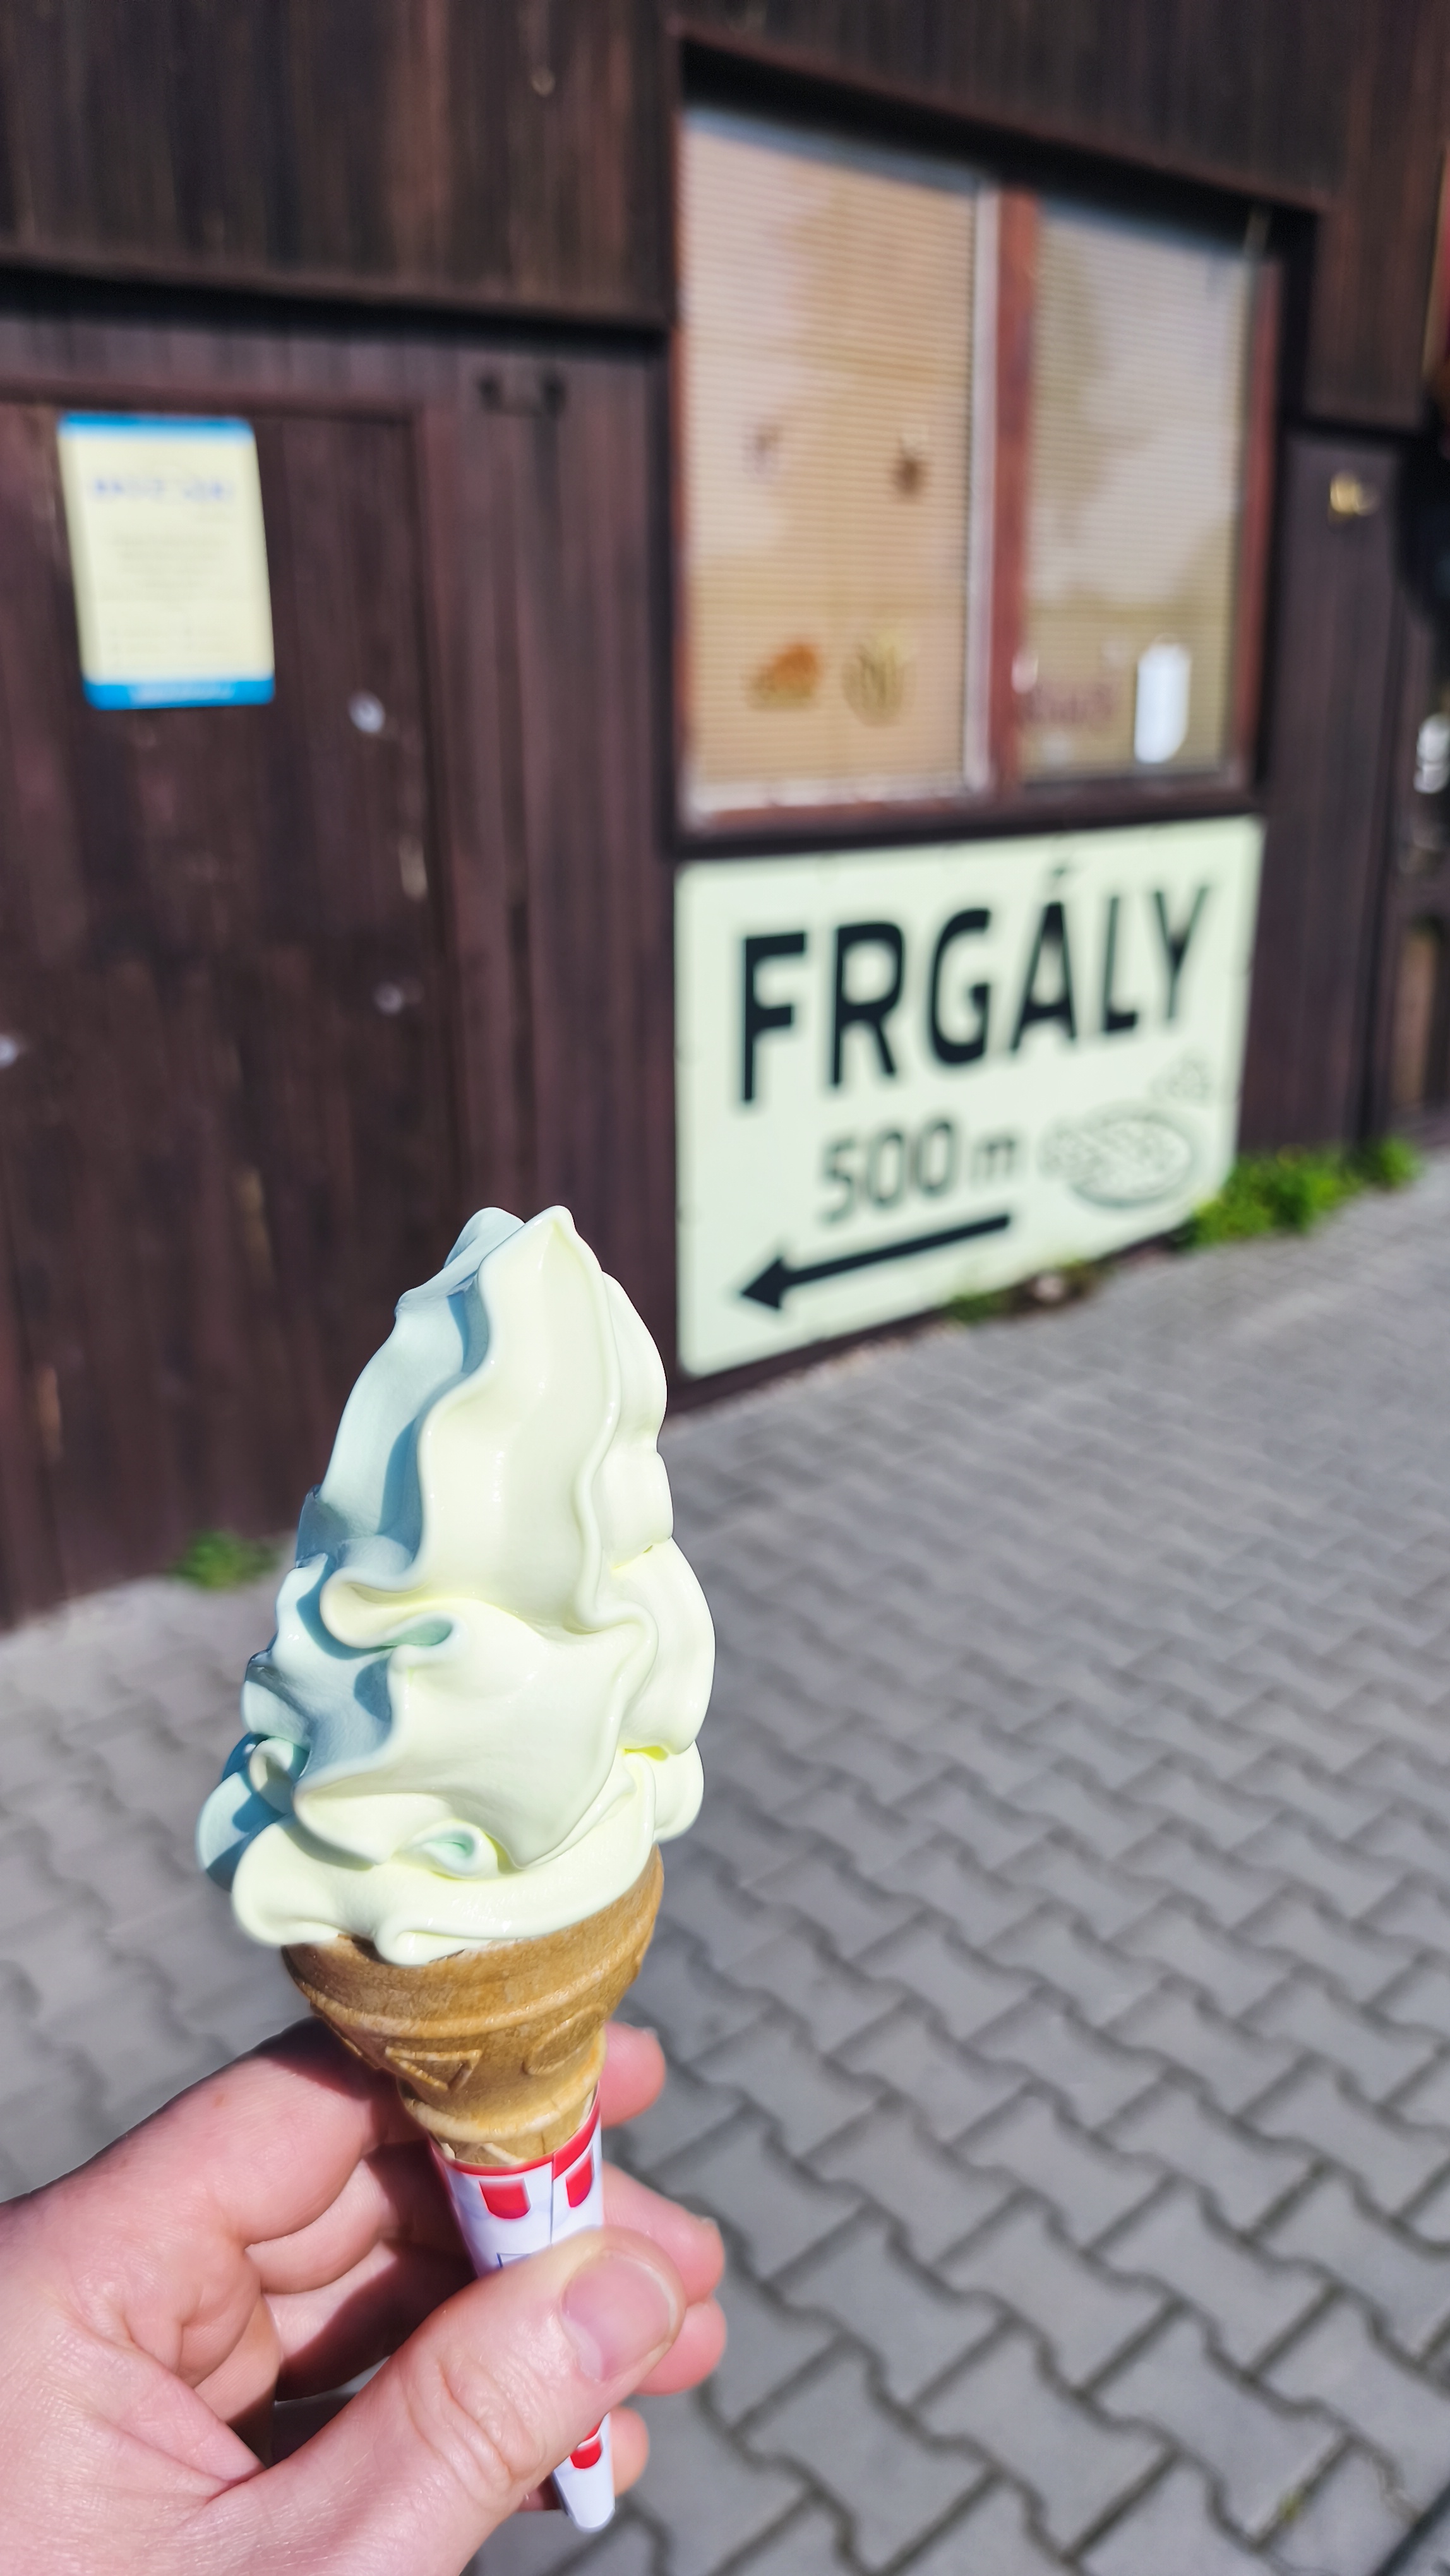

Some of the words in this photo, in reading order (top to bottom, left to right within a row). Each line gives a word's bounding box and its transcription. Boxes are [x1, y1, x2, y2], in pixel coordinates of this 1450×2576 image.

[737, 862, 1211, 1105] FRGÁLY
[820, 1116, 956, 1225] 500
[966, 1135, 1021, 1187] m
